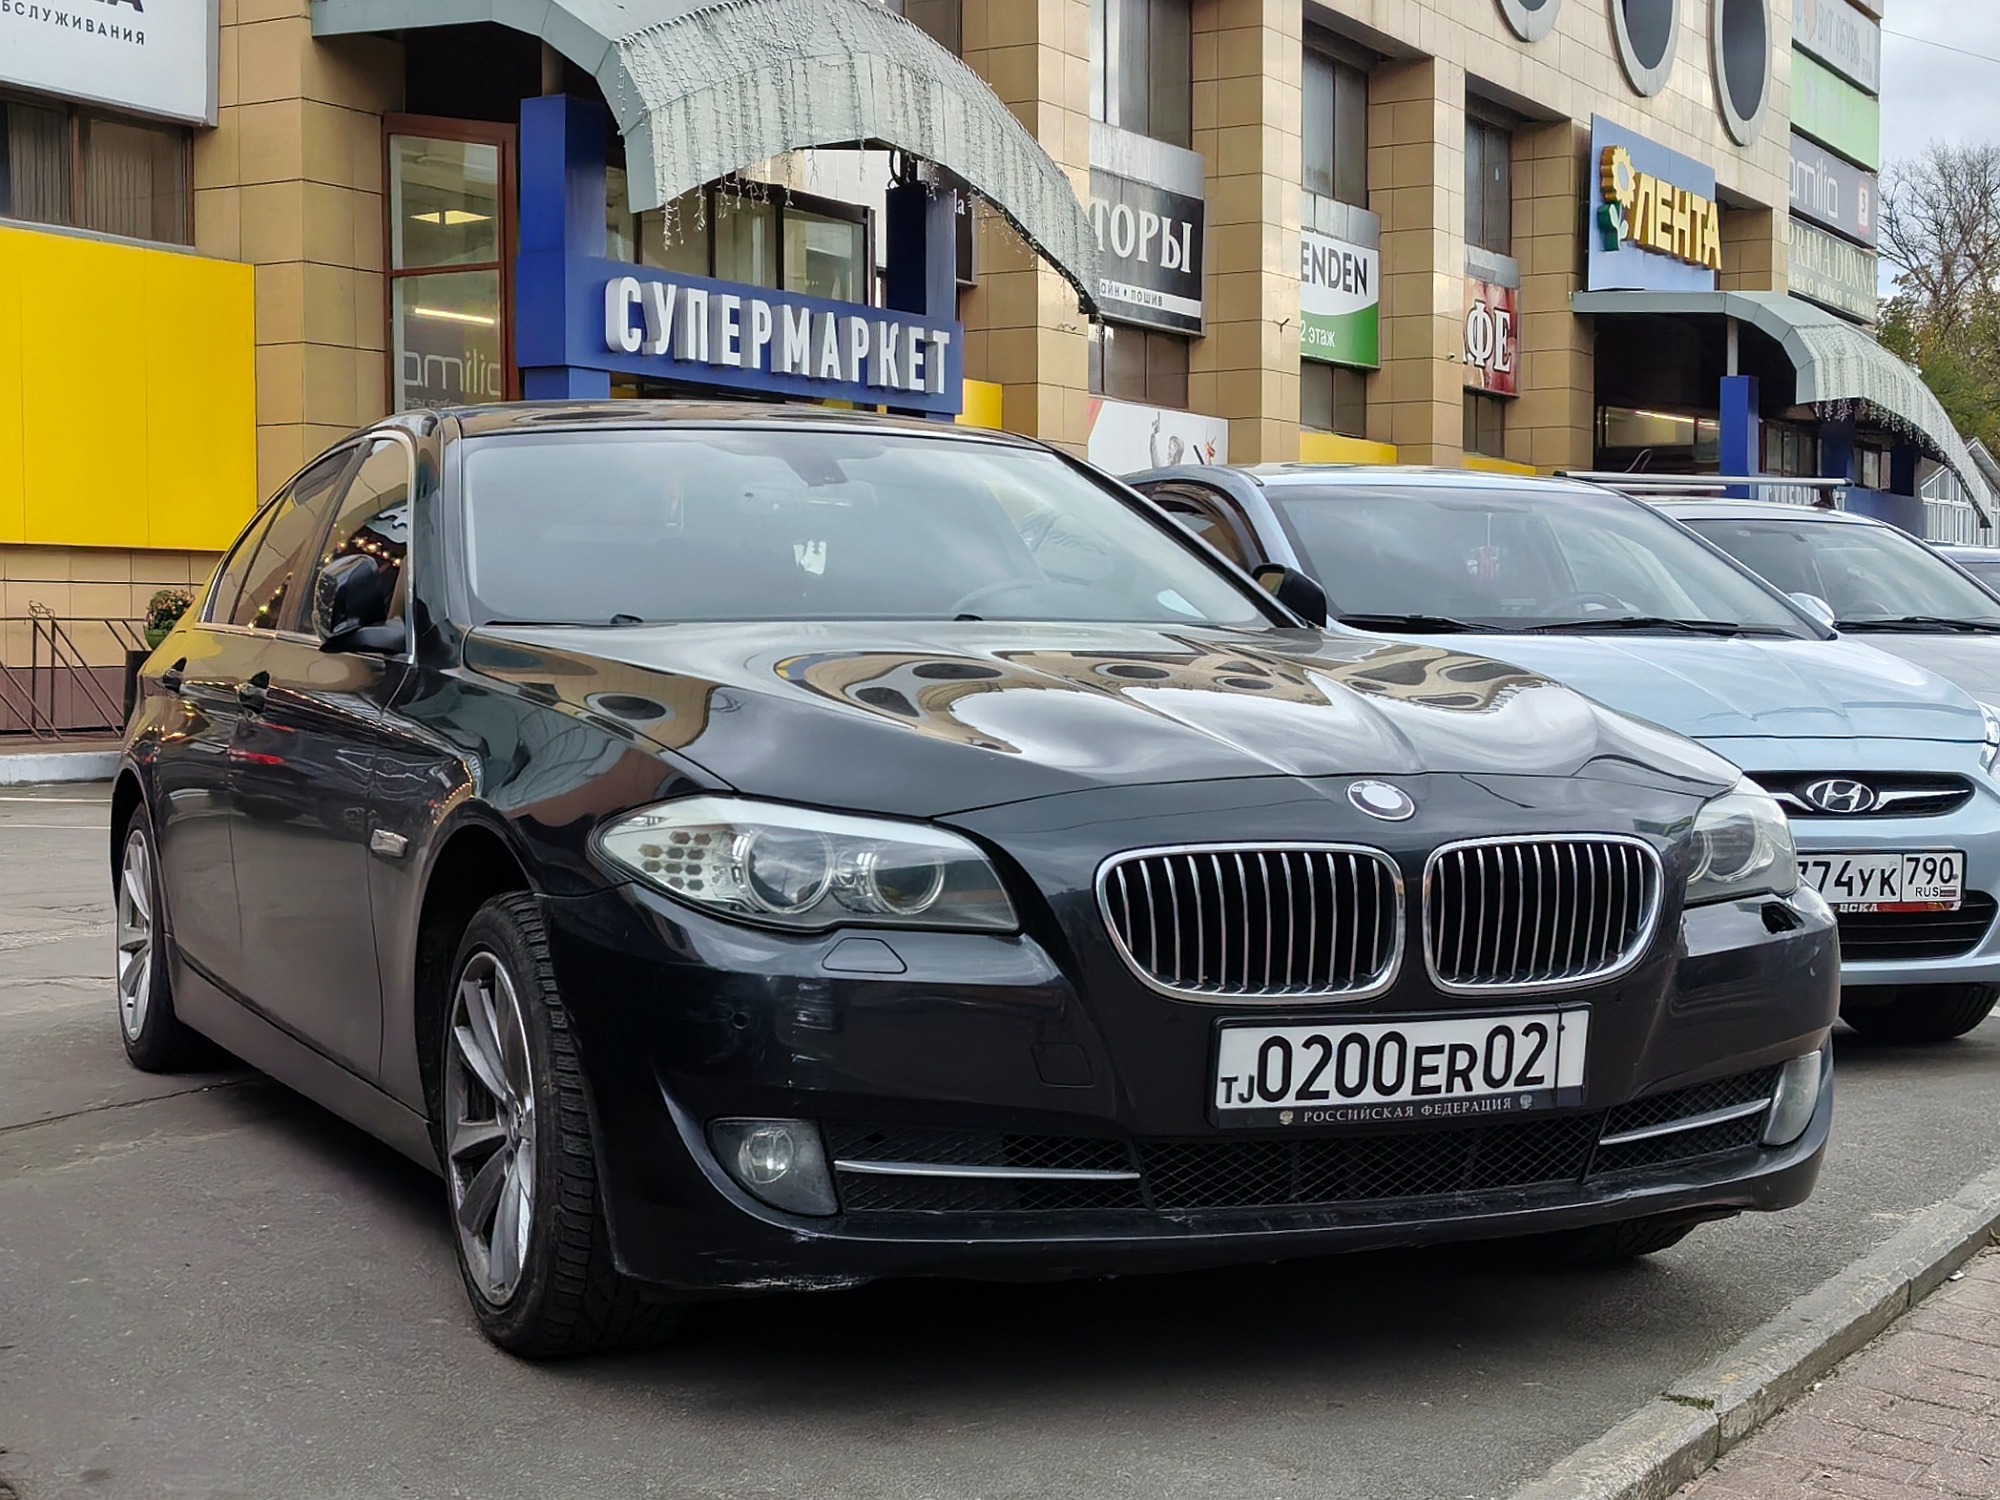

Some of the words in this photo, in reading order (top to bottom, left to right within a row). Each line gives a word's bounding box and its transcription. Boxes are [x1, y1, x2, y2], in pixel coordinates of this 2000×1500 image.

[2, 0, 145, 45] БСЛУЖИВАНИЯ
[1089, 196, 1193, 273] ТОРЫ
[1632, 171, 1722, 270] ЛЕНТА
[1301, 240, 1368, 297] ENDEN
[1834, 243, 1876, 298] DONNA
[606, 276, 951, 395] СУПЕРМАРКЕТ
[1308, 326, 1336, 348] этаж
[1463, 299, 1512, 374] ФЕ
[1906, 856, 1955, 886] 790
[1915, 886, 1939, 898] RUS
[1839, 902, 1879, 913] ЦСКА
[1221, 1074, 1256, 1104] TJ
[1303, 1105, 1415, 1124] РОССИЙСКАЯ
[1420, 1096, 1513, 1117] ФЕДЕРАЦИЯ
